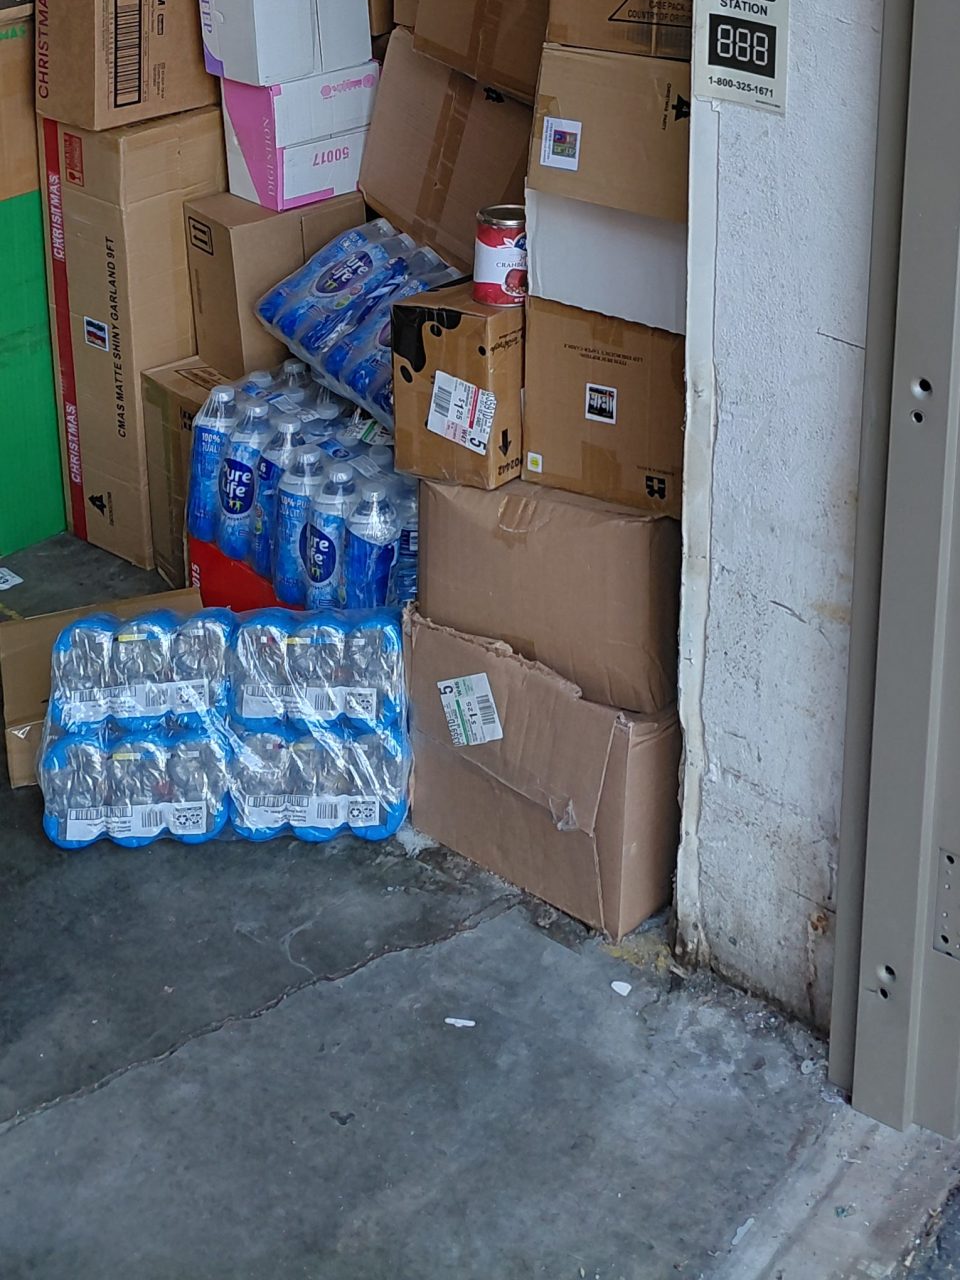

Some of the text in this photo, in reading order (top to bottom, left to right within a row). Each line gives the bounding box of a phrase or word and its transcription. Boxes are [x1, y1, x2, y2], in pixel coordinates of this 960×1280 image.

[717, 24, 769, 66] 888
[708, 76, 775, 98] 1-800-325-1671
[262, 117, 276, 197] DIGESTION
[312, 146, 350, 167] 50017
[49, 172, 65, 261] CHRISTMAS
[105, 236, 127, 438] CMAS MATTE SHINY GARLAND 9FT
[66, 402, 81, 485] CHRISTMAS
[202, 432, 221, 444] 100%
[470, 437, 487, 451] 5
[439, 685, 454, 695] 5
